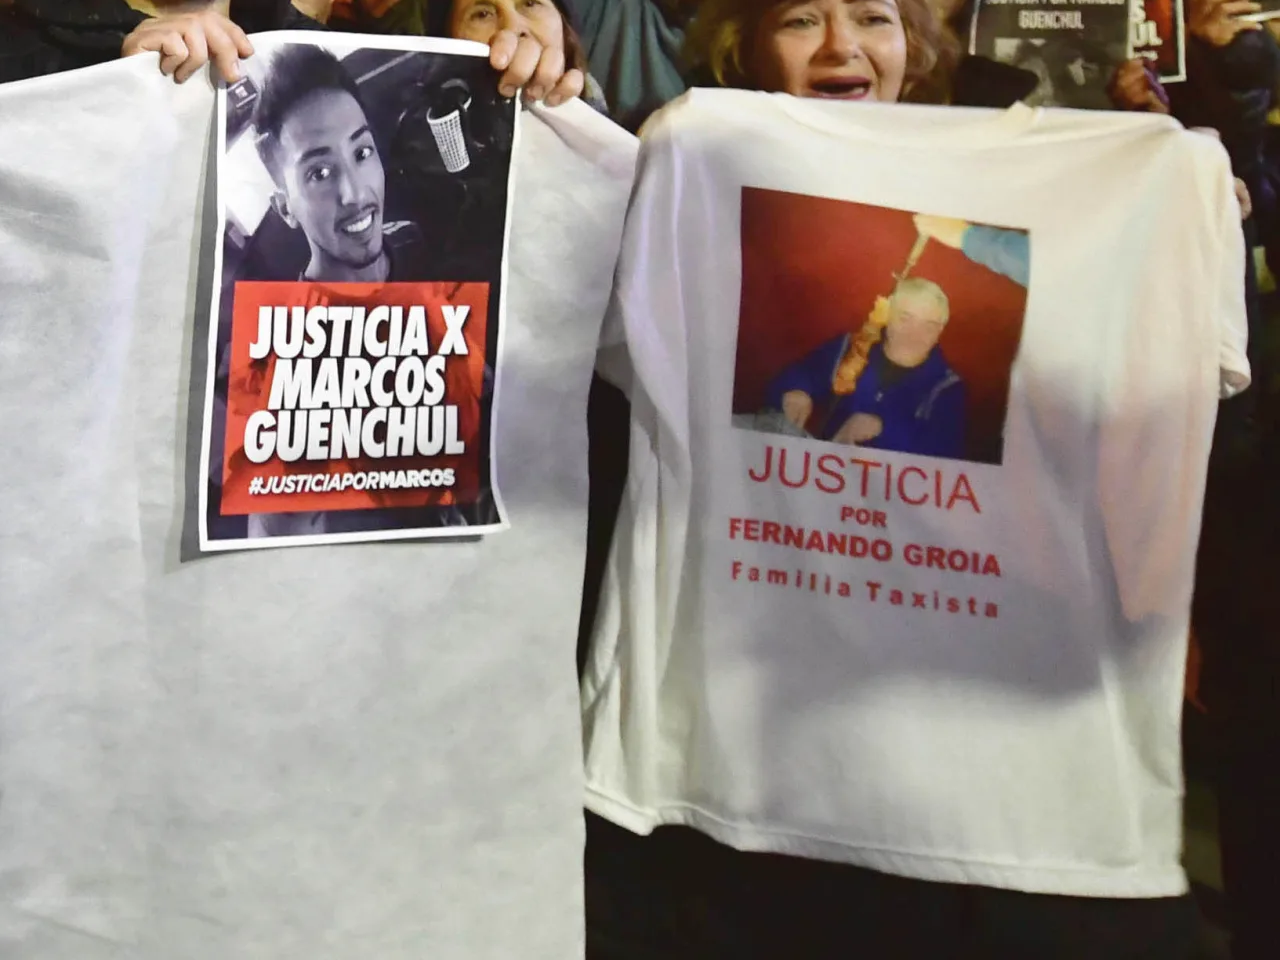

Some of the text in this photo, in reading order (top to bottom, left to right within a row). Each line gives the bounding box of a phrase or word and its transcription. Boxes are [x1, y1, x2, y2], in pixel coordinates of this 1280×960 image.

[1018, 9, 1085, 30] GUENCHUL
[248, 305, 471, 360] JUSTICIA X
[267, 354, 447, 411] MARCOS
[243, 405, 466, 464] GUENCHUL
[248, 468, 456, 496] #JUSTICIAPORMARCOS
[748, 445, 982, 515] JUSTICIA
[840, 505, 887, 529] POR
[728, 517, 1003, 578] FERNANDO GROIA
[731, 560, 1000, 619] Familia Taxista
